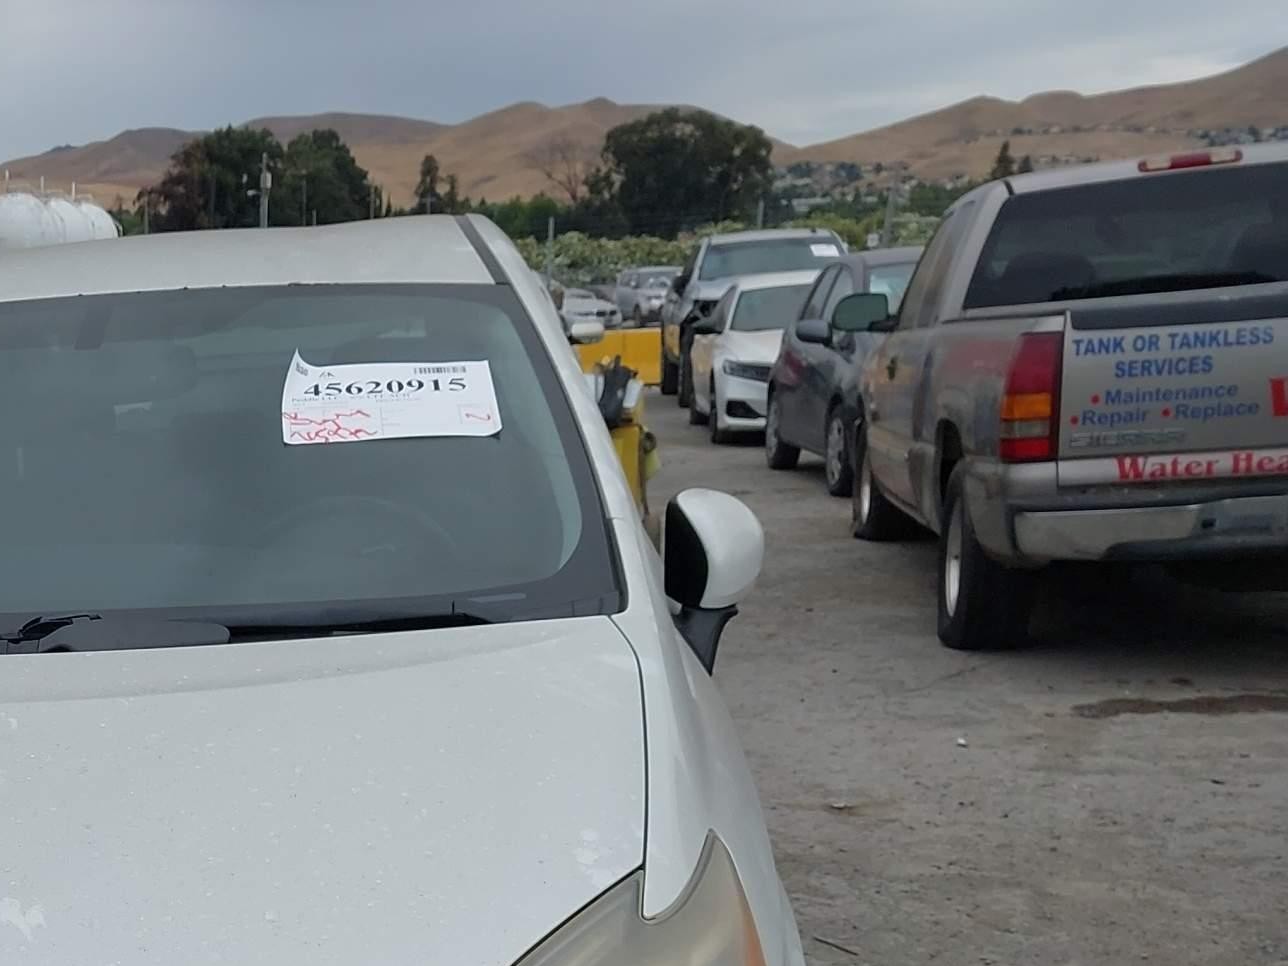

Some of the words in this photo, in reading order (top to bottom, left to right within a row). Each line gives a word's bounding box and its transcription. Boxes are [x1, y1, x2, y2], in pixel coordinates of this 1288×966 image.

[1072, 335, 1125, 356] TANK
[1132, 334, 1160, 352] OR
[1168, 326, 1274, 350] TANKLESS
[1114, 355, 1214, 378] SERVICES
[303, 377, 466, 397] 45620915
[1103, 383, 1239, 405] Maintenance
[1081, 408, 1149, 428] Repair
[1174, 402, 1259, 424] Replace
[1114, 455, 1219, 482] Water
